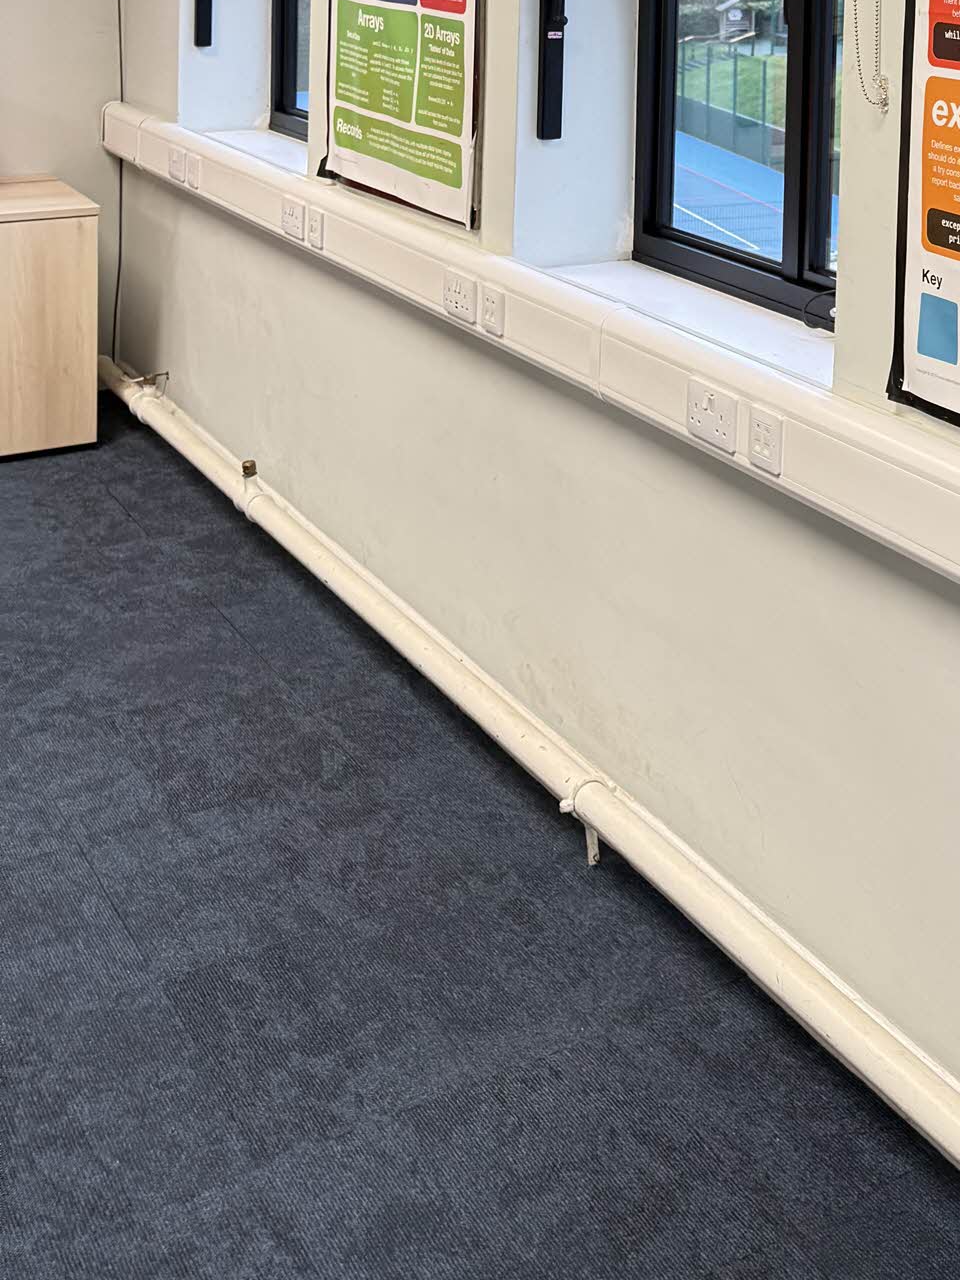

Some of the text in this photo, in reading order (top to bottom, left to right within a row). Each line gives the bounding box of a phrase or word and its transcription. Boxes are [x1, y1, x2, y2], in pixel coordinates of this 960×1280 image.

[357, 8, 384, 32] Arrays
[424, 23, 460, 46] 2D Arrays
[336, 118, 363, 140] Records
[921, 268, 943, 290] Key
